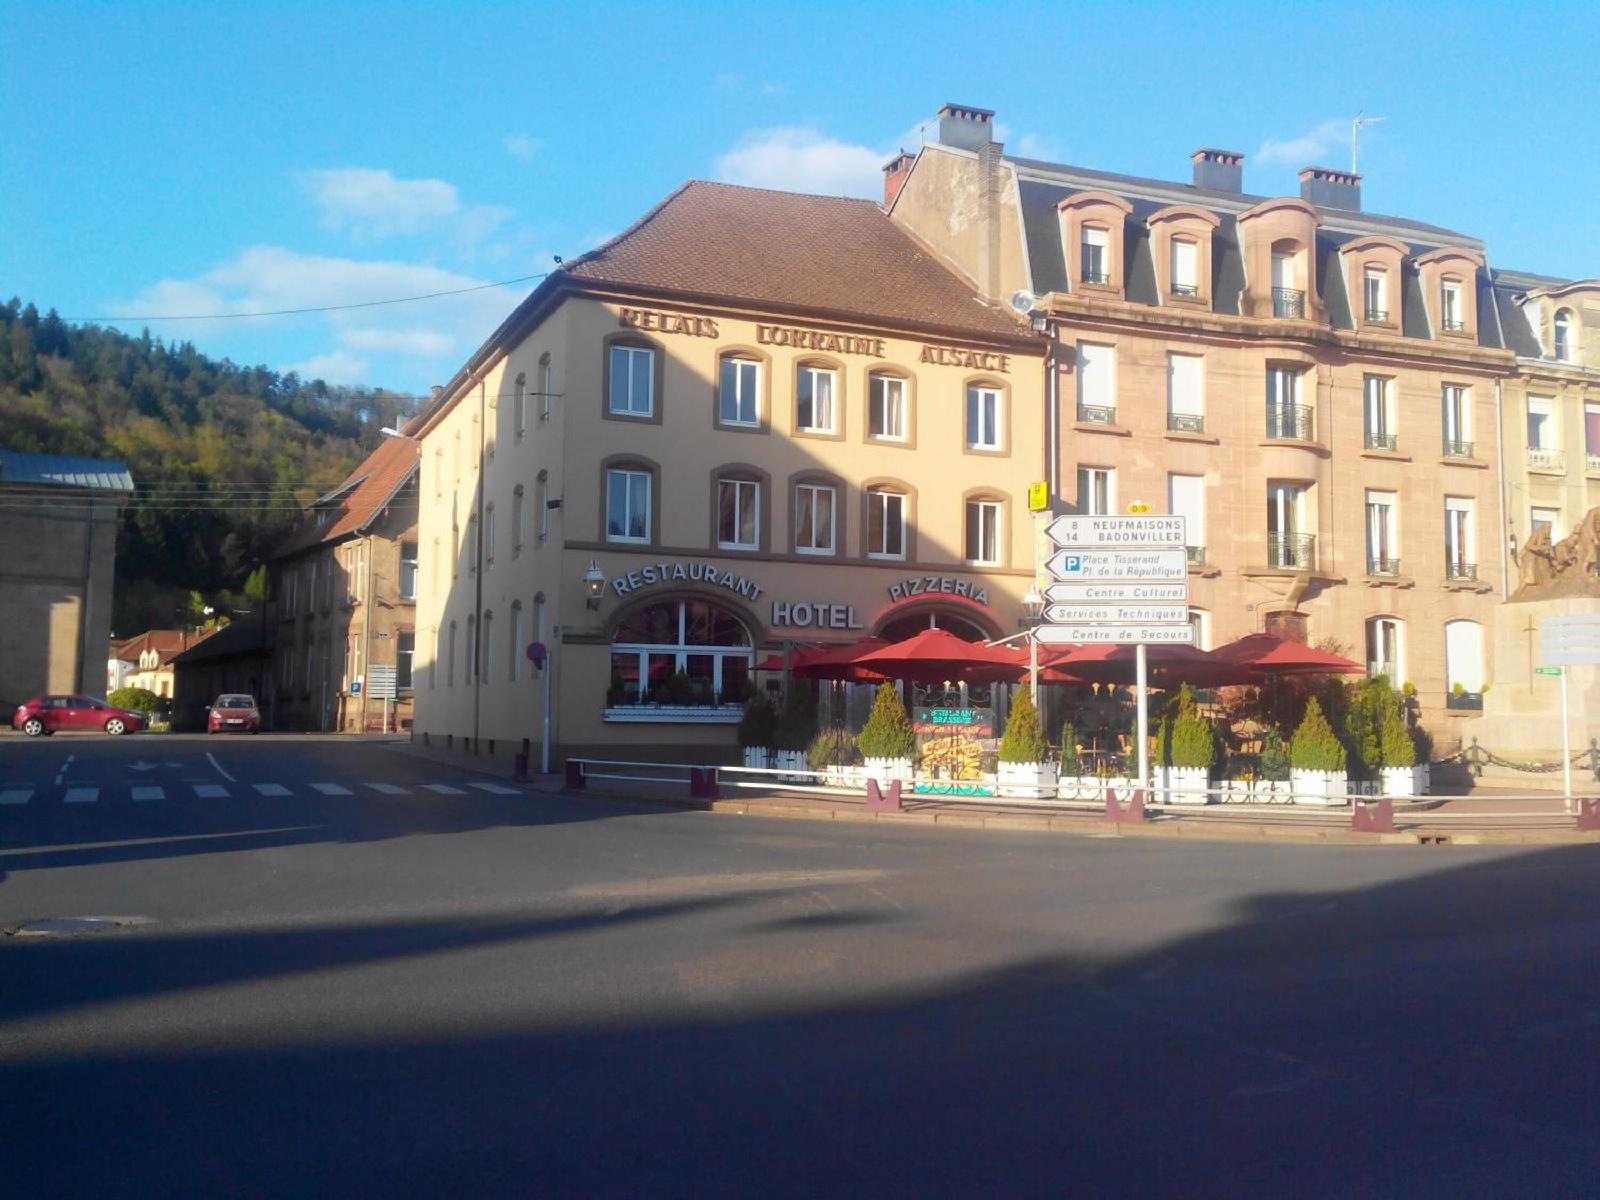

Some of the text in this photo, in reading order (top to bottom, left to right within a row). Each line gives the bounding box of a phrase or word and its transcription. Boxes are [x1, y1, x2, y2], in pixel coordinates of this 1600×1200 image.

[619, 307, 1012, 374] RELAIS LORRAINE ALSACE
[1072, 521, 1181, 530] 8 NEUFMAISONS
[1066, 532, 1181, 542] 14 BADONVILLER
[1082, 555, 1160, 565] Place Tisserand
[1098, 566, 1110, 576] de
[1114, 566, 1123, 576] la
[1126, 566, 1182, 578] République
[612, 563, 764, 601] RESTAURANT
[889, 576, 989, 605] PIZZERIA
[1086, 588, 1183, 597] Centre Culturel
[772, 601, 864, 628] HOTEL
[1059, 609, 1183, 620] Services Techniques
[1072, 630, 1188, 639] Centre de Secours
